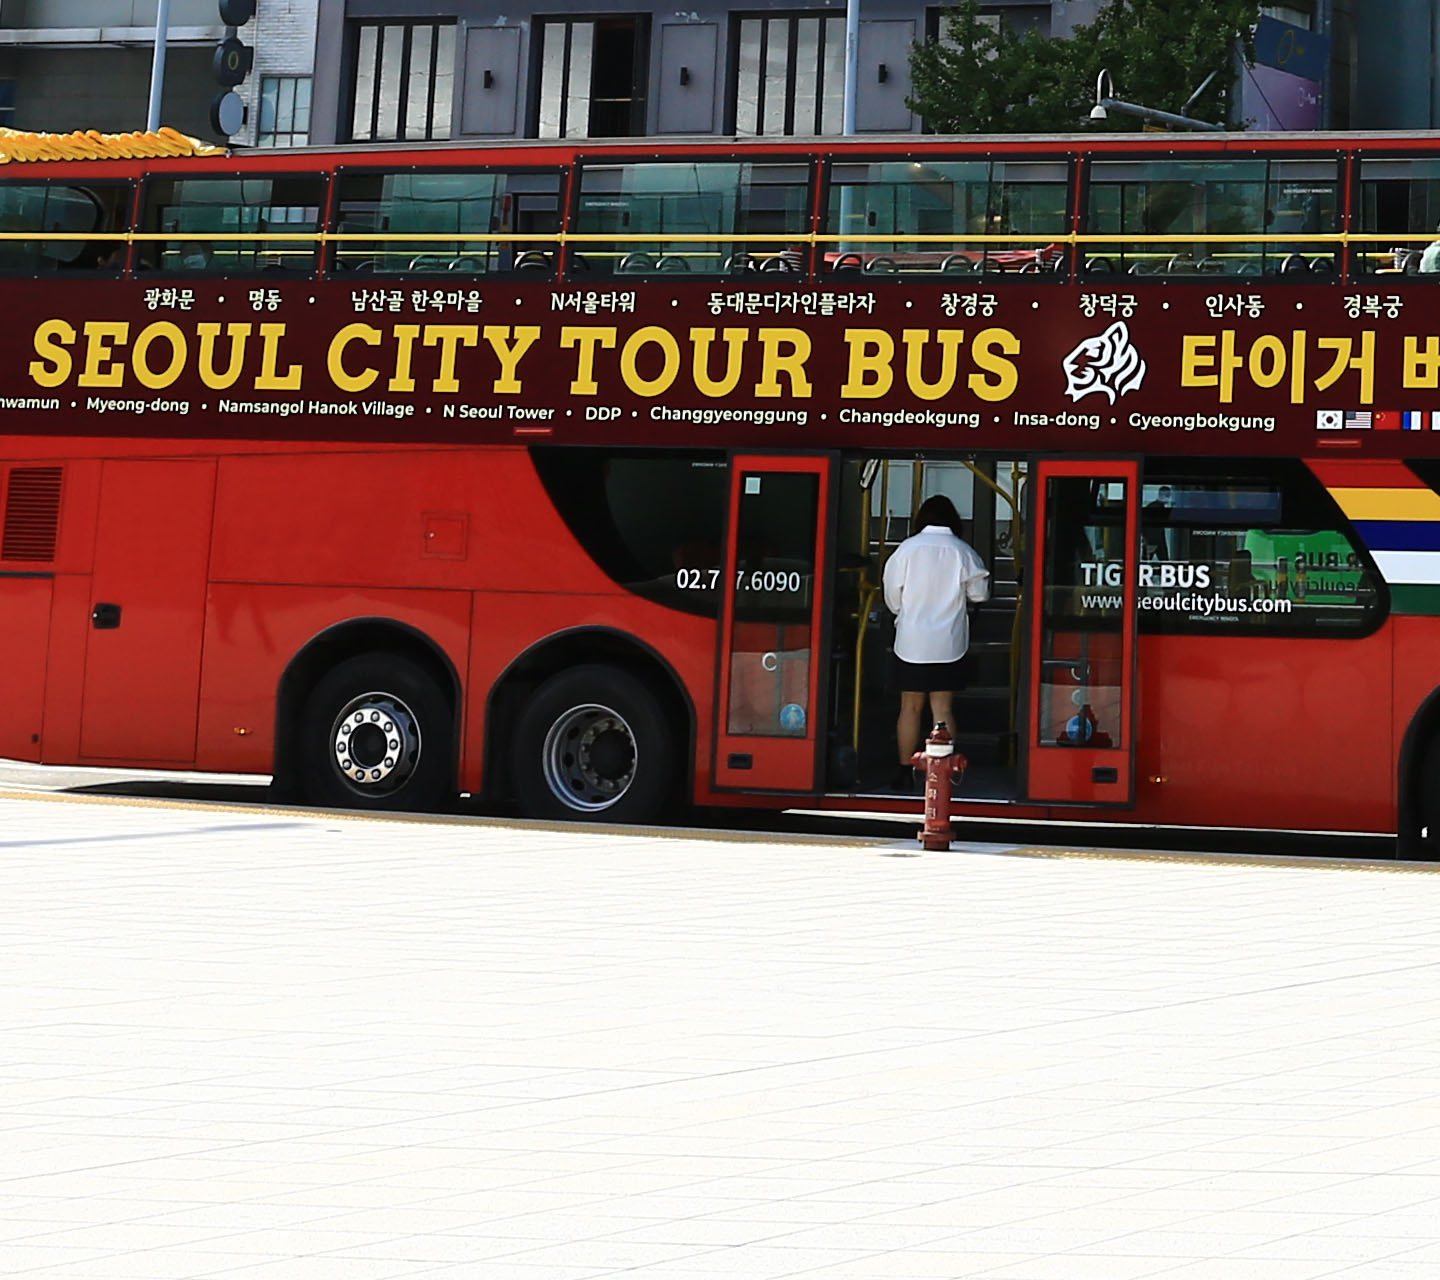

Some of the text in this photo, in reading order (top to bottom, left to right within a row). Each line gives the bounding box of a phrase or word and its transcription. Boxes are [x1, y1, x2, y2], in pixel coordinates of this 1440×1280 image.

[144, 288, 1404, 319] 광화문 명동 남산골 한옥마을 N서울타워 동대문디자인플라자 창경궁 창덕궁 인사동 경복궁
[28, 318, 303, 391] SEOUL
[327, 322, 542, 394] CITY
[560, 325, 814, 398] TOUR
[840, 327, 1022, 402] BUS
[1181, 329, 1376, 405] 타이거
[86, 396, 190, 416] Myeong-dong
[218, 398, 304, 417] Namsangol
[308, 399, 358, 416] Hanok
[361, 401, 415, 420] Village
[443, 404, 455, 418] N
[459, 403, 503, 419] Seoul
[507, 405, 555, 421] Tower
[585, 406, 622, 421] DDP
[650, 406, 809, 427] Changgyeonggung
[839, 408, 981, 429] Changdeokgung
[1013, 410, 1101, 430] Insa-dong
[1128, 412, 1276, 433] Gyeongbokgung
[676, 568, 801, 592] 02.77.6090
[1080, 562, 1211, 588] TIGR BUS
[1081, 593, 1292, 616] wwweoulcitybus.com
